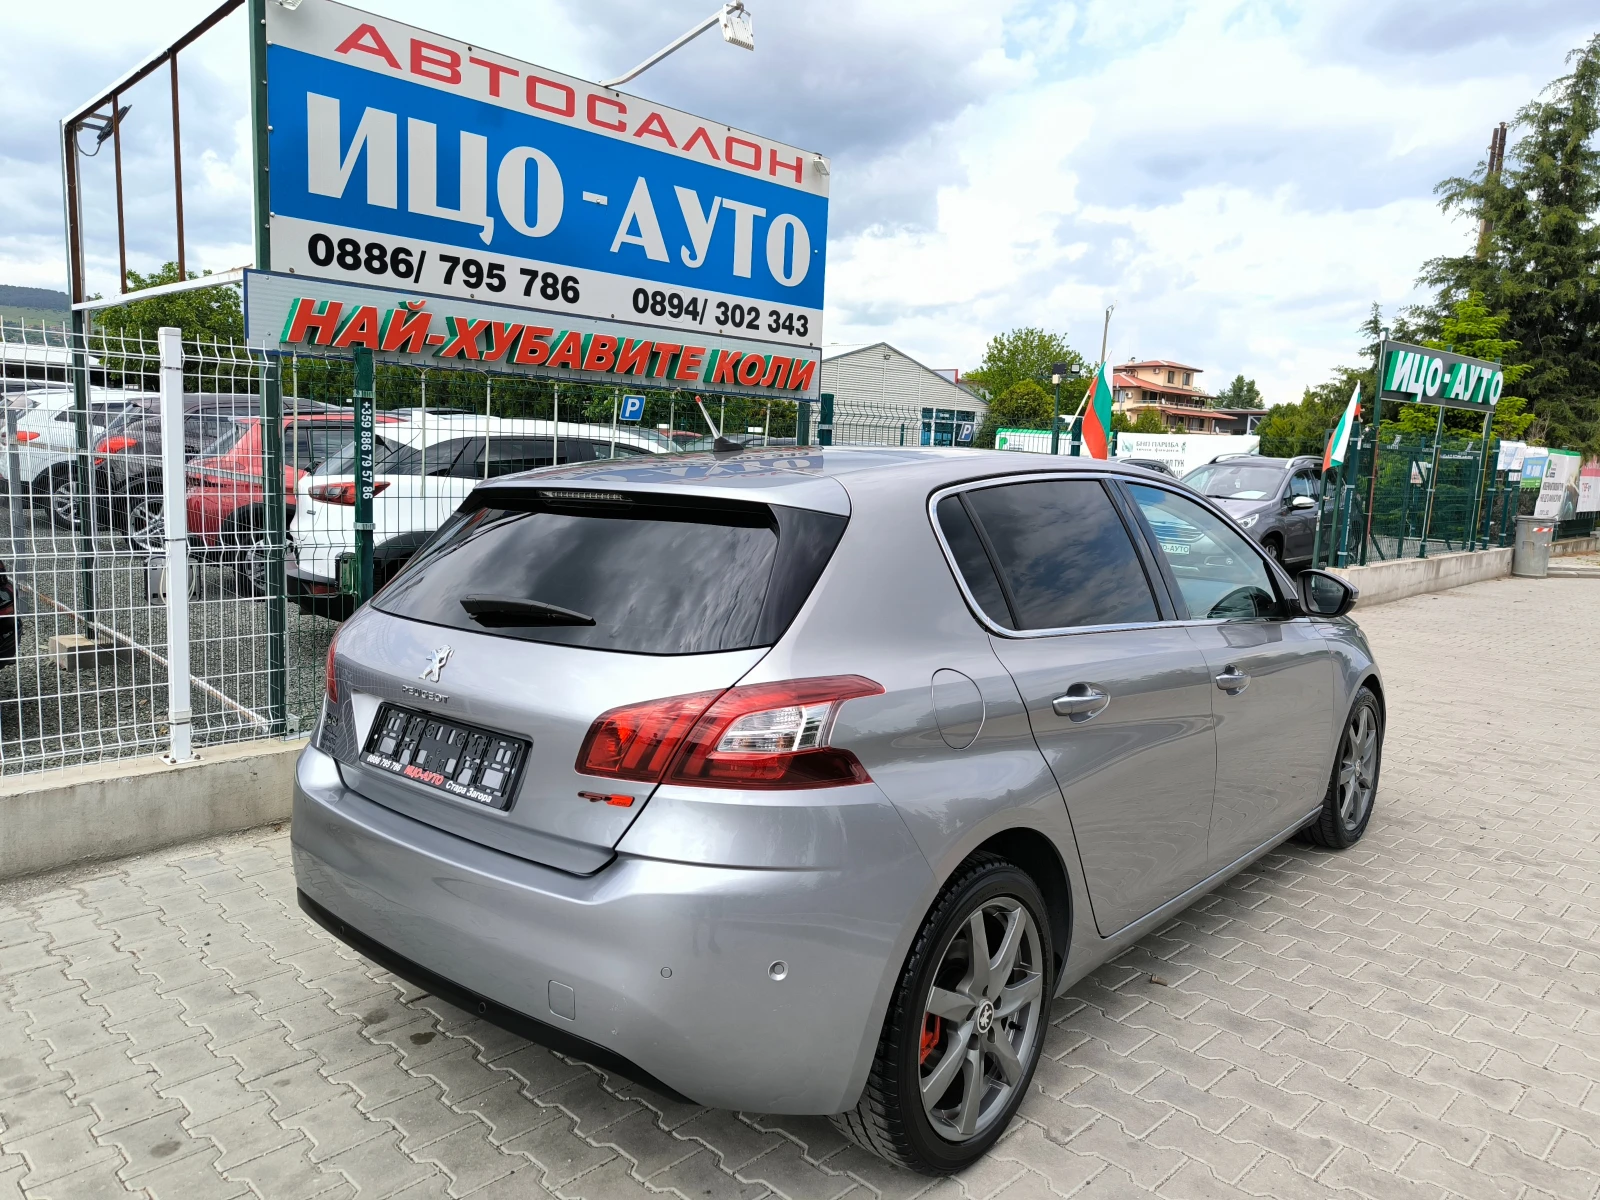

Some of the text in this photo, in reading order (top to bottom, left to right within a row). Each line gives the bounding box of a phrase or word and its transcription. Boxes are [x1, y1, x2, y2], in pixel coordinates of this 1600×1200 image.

[334, 22, 803, 184] АВТОСАЛОН
[307, 232, 581, 304] 0886/ 795 786
[281, 297, 816, 391] НАЙ-ХУБАВИТЕ КОЛИ
[632, 287, 809, 338] 0894/ 302 343
[1386, 350, 1504, 406] ИЦО-АУТО
[361, 401, 374, 500] +359 886 79 57 86
[401, 684, 450, 704] PEUGEOT
[445, 780, 467, 795] Стара
[466, 787, 493, 803] Загора
